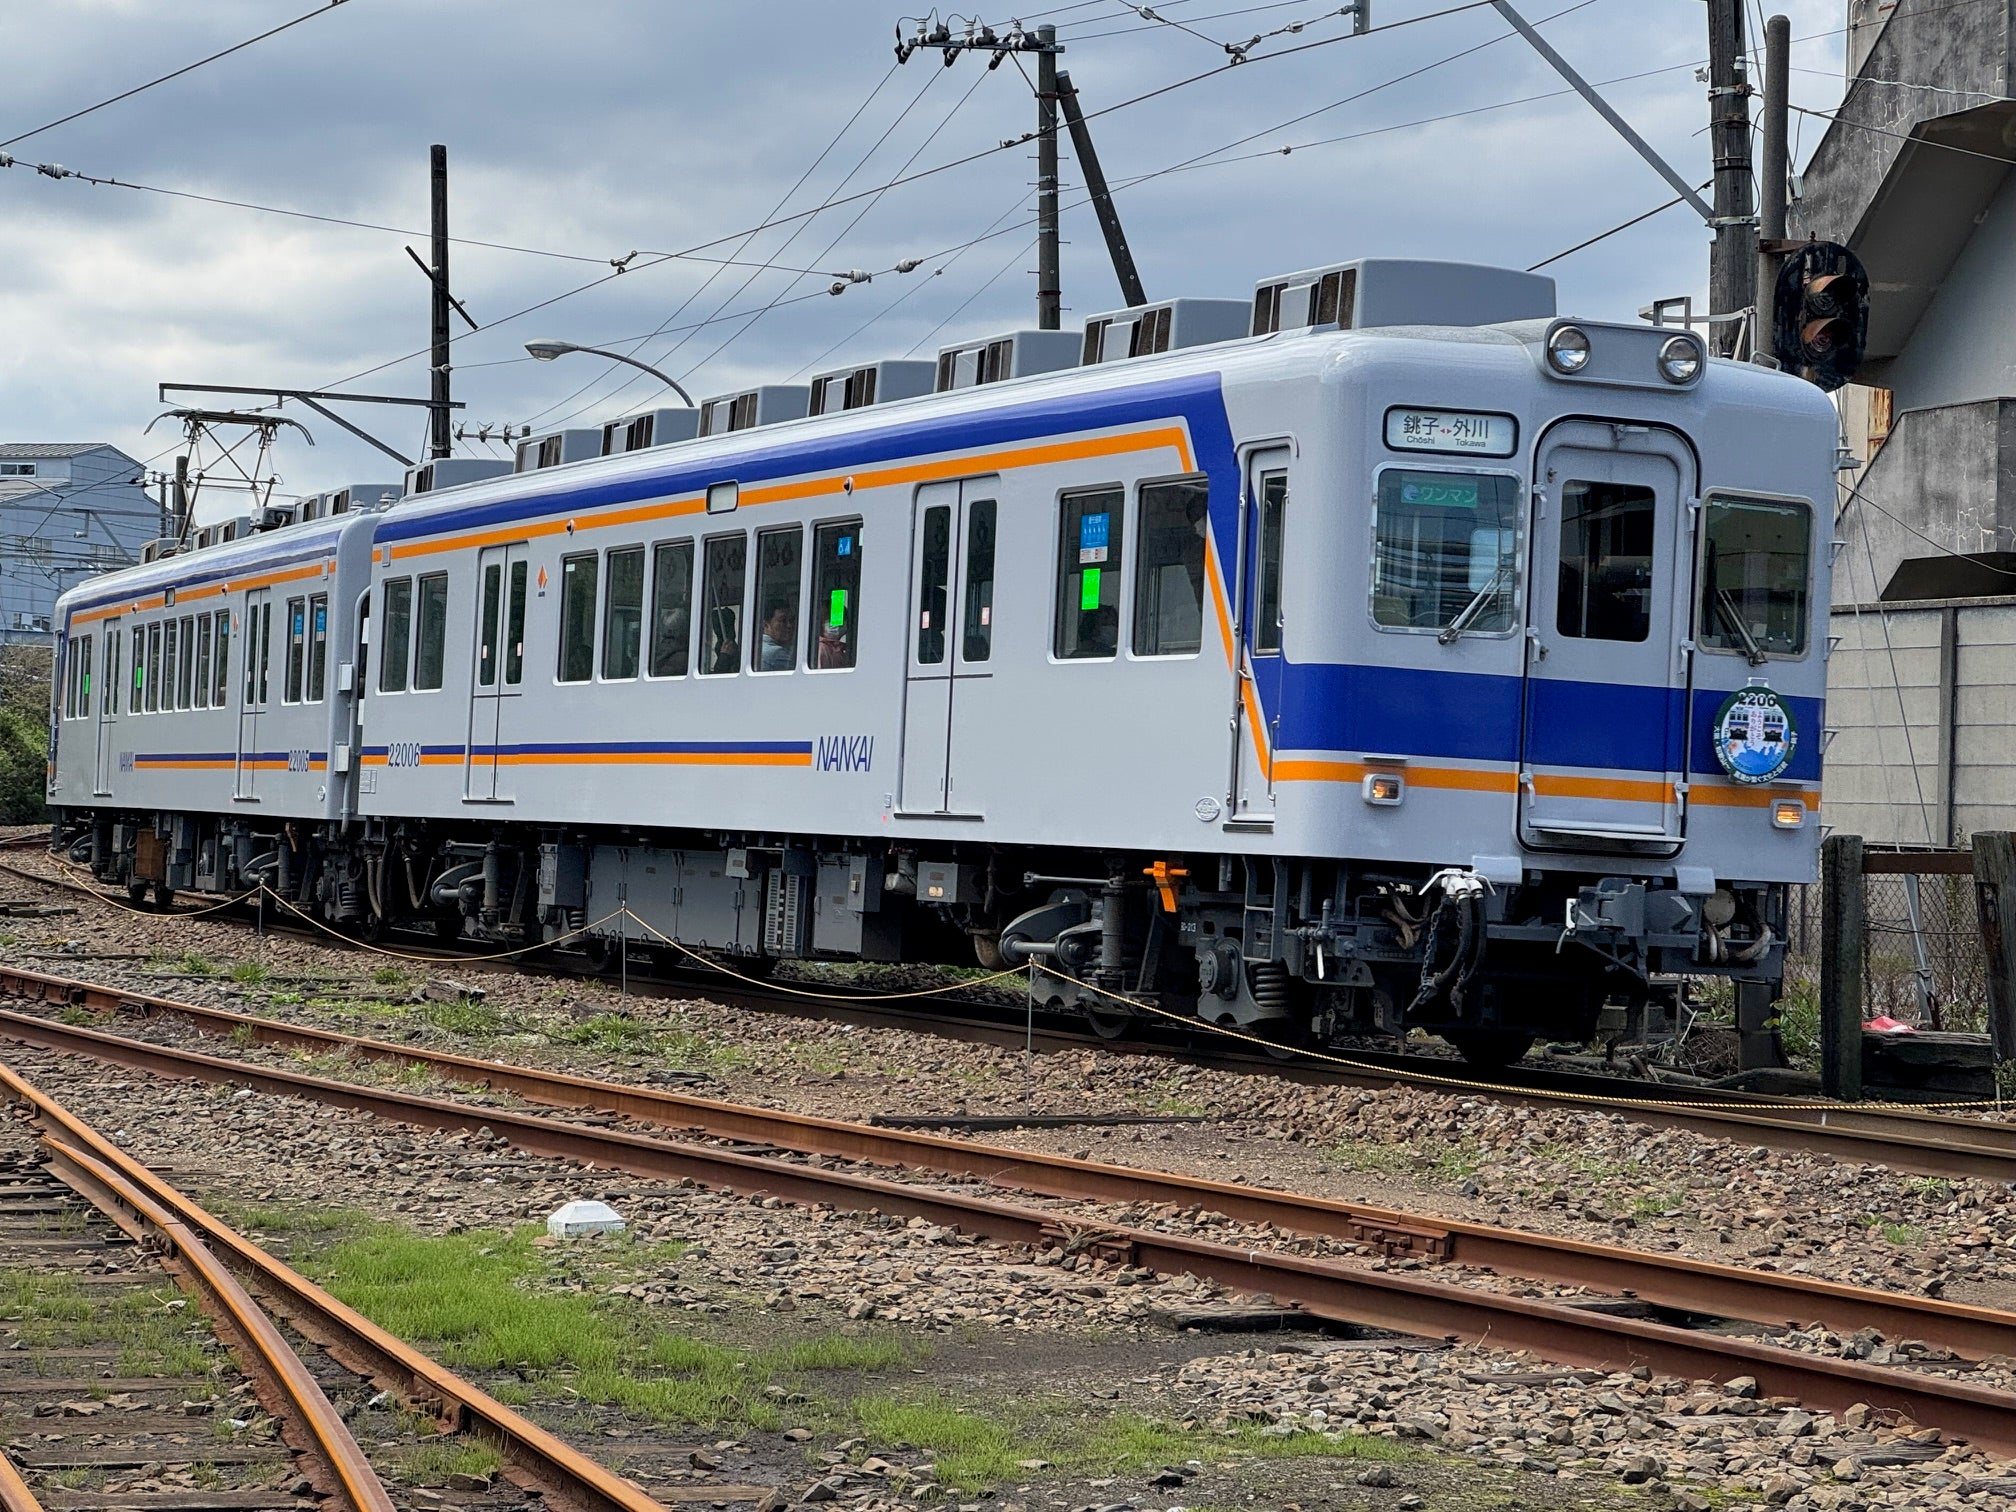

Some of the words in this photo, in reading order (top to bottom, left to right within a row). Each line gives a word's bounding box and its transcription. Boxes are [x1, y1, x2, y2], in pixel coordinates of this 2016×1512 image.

[1403, 415, 1439, 435] 銚子
[1453, 418, 1489, 438] 外川
[1455, 438, 1486, 448] Tokawa
[1420, 486, 1478, 503] ワンマン
[1738, 692, 1777, 707] 2206
[288, 749, 309, 772] 22005
[388, 742, 420, 767] 22006
[816, 735, 874, 772] NANKAI
